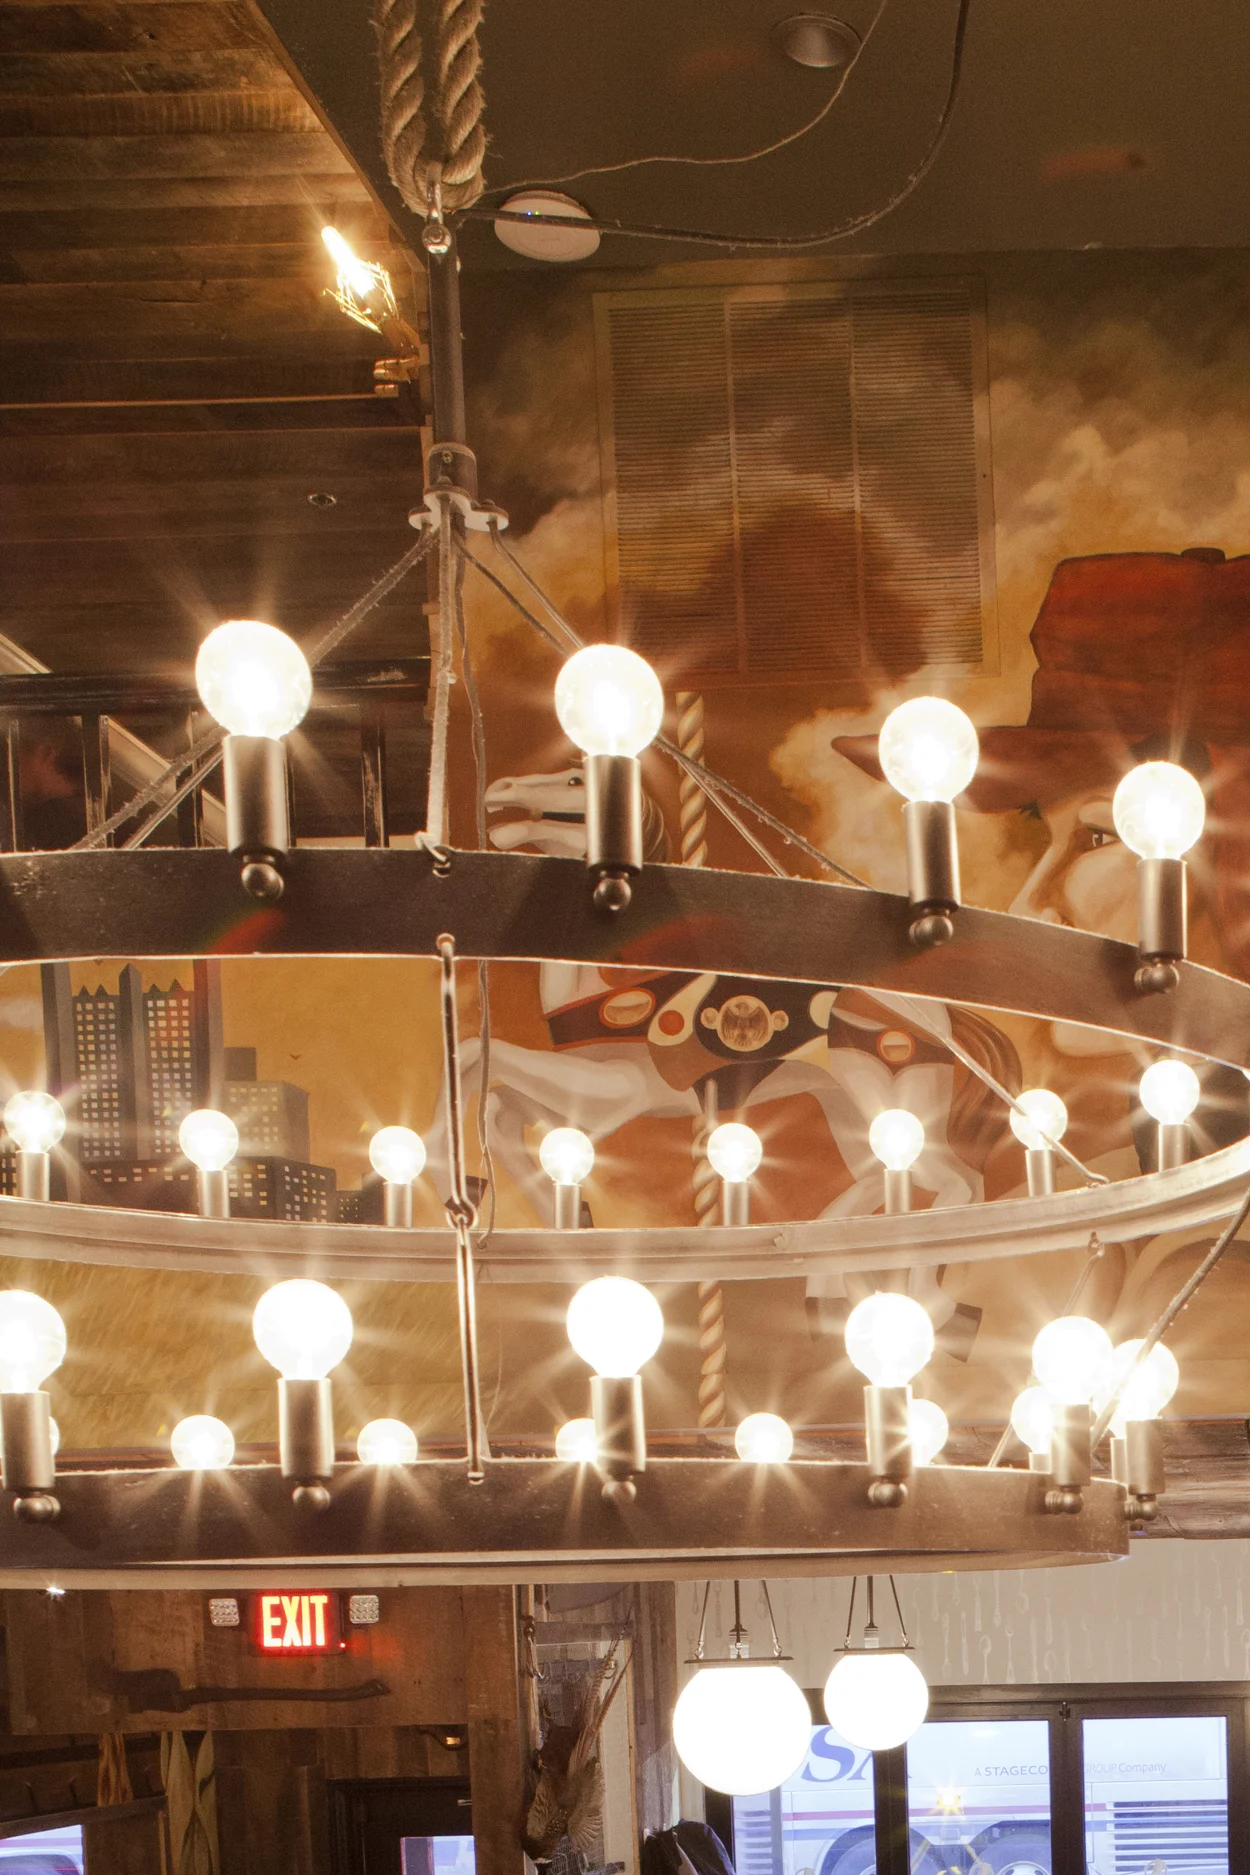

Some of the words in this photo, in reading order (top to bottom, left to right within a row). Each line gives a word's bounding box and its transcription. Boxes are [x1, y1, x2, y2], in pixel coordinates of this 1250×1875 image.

[262, 1595, 328, 1647] EXIT
[984, 1764, 1048, 1777] STAGECO
[1118, 1761, 1167, 1776] Company
